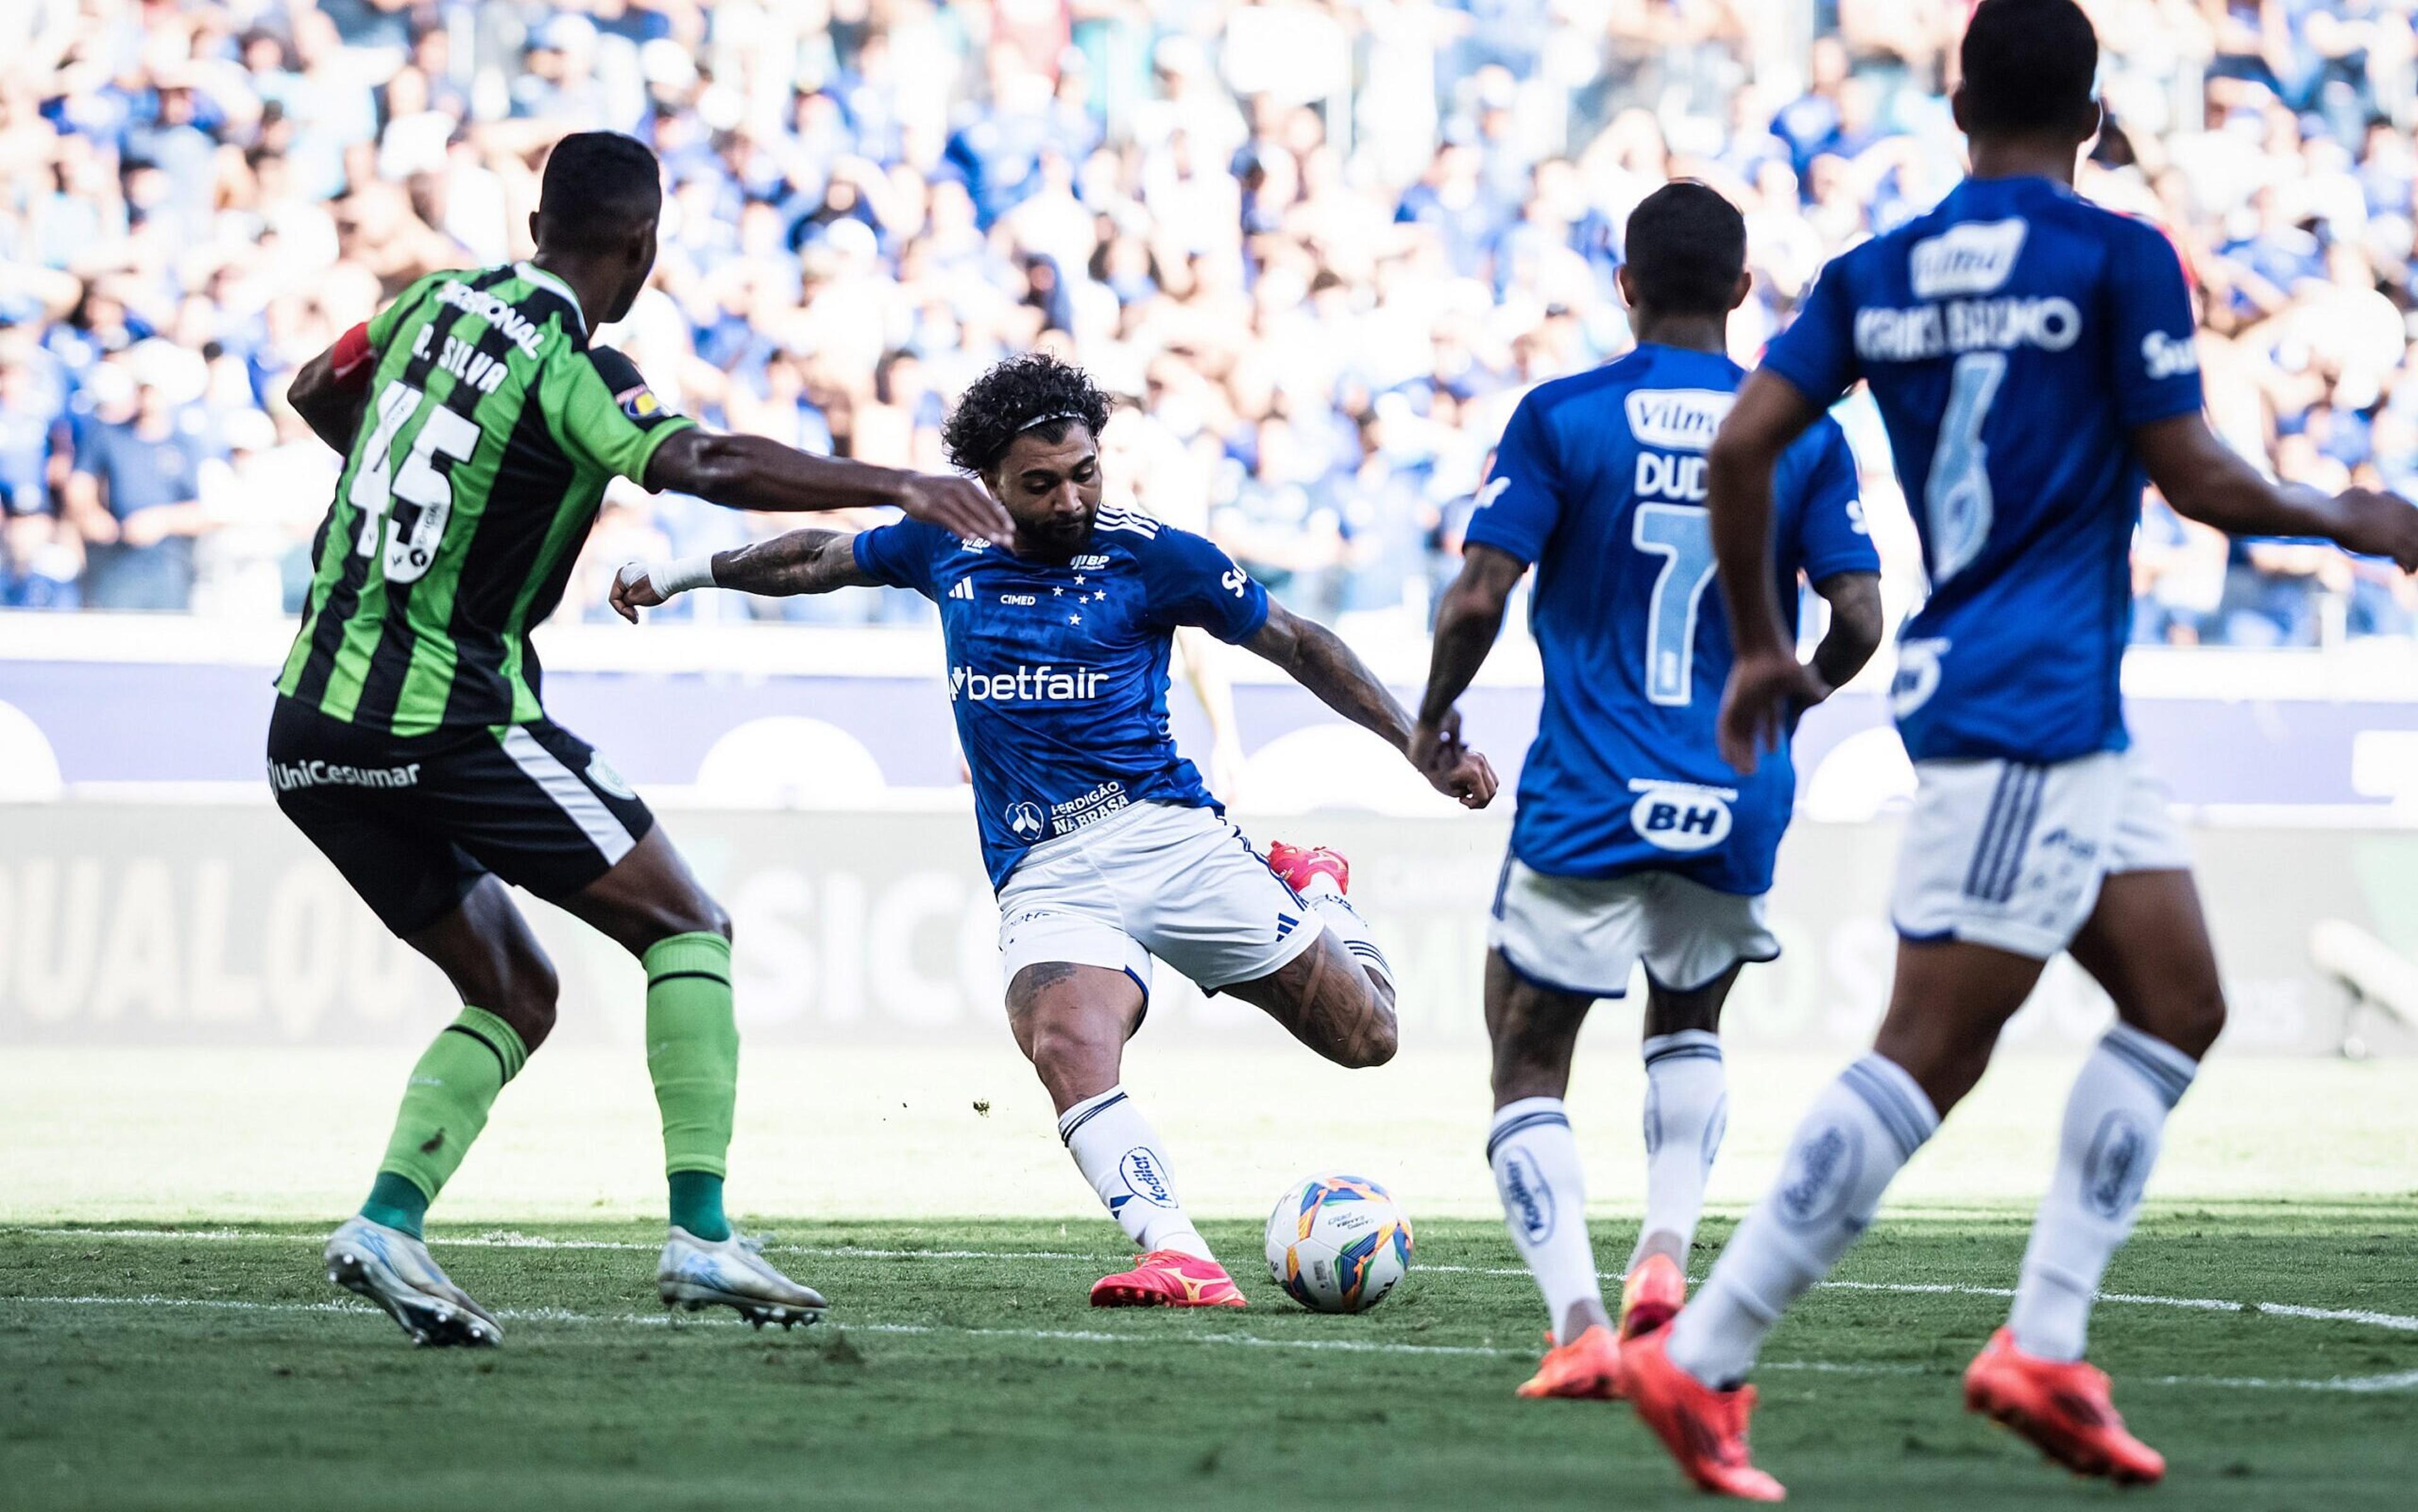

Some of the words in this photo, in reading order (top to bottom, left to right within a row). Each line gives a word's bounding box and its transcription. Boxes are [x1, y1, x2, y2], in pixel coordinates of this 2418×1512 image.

[411, 322, 434, 361] R.
[437, 334, 509, 395] SILVA
[347, 379, 482, 584] 45
[1634, 451, 1710, 502] DUD
[1000, 594, 1036, 606] CIMED
[1632, 501, 1719, 707] 7
[966, 665, 1110, 701] betfair
[275, 759, 421, 792] UniCesumar
[1646, 803, 1719, 836] BH
[0, 856, 412, 1042] UALQU
[1131, 1155, 1172, 1202] Kodilar
